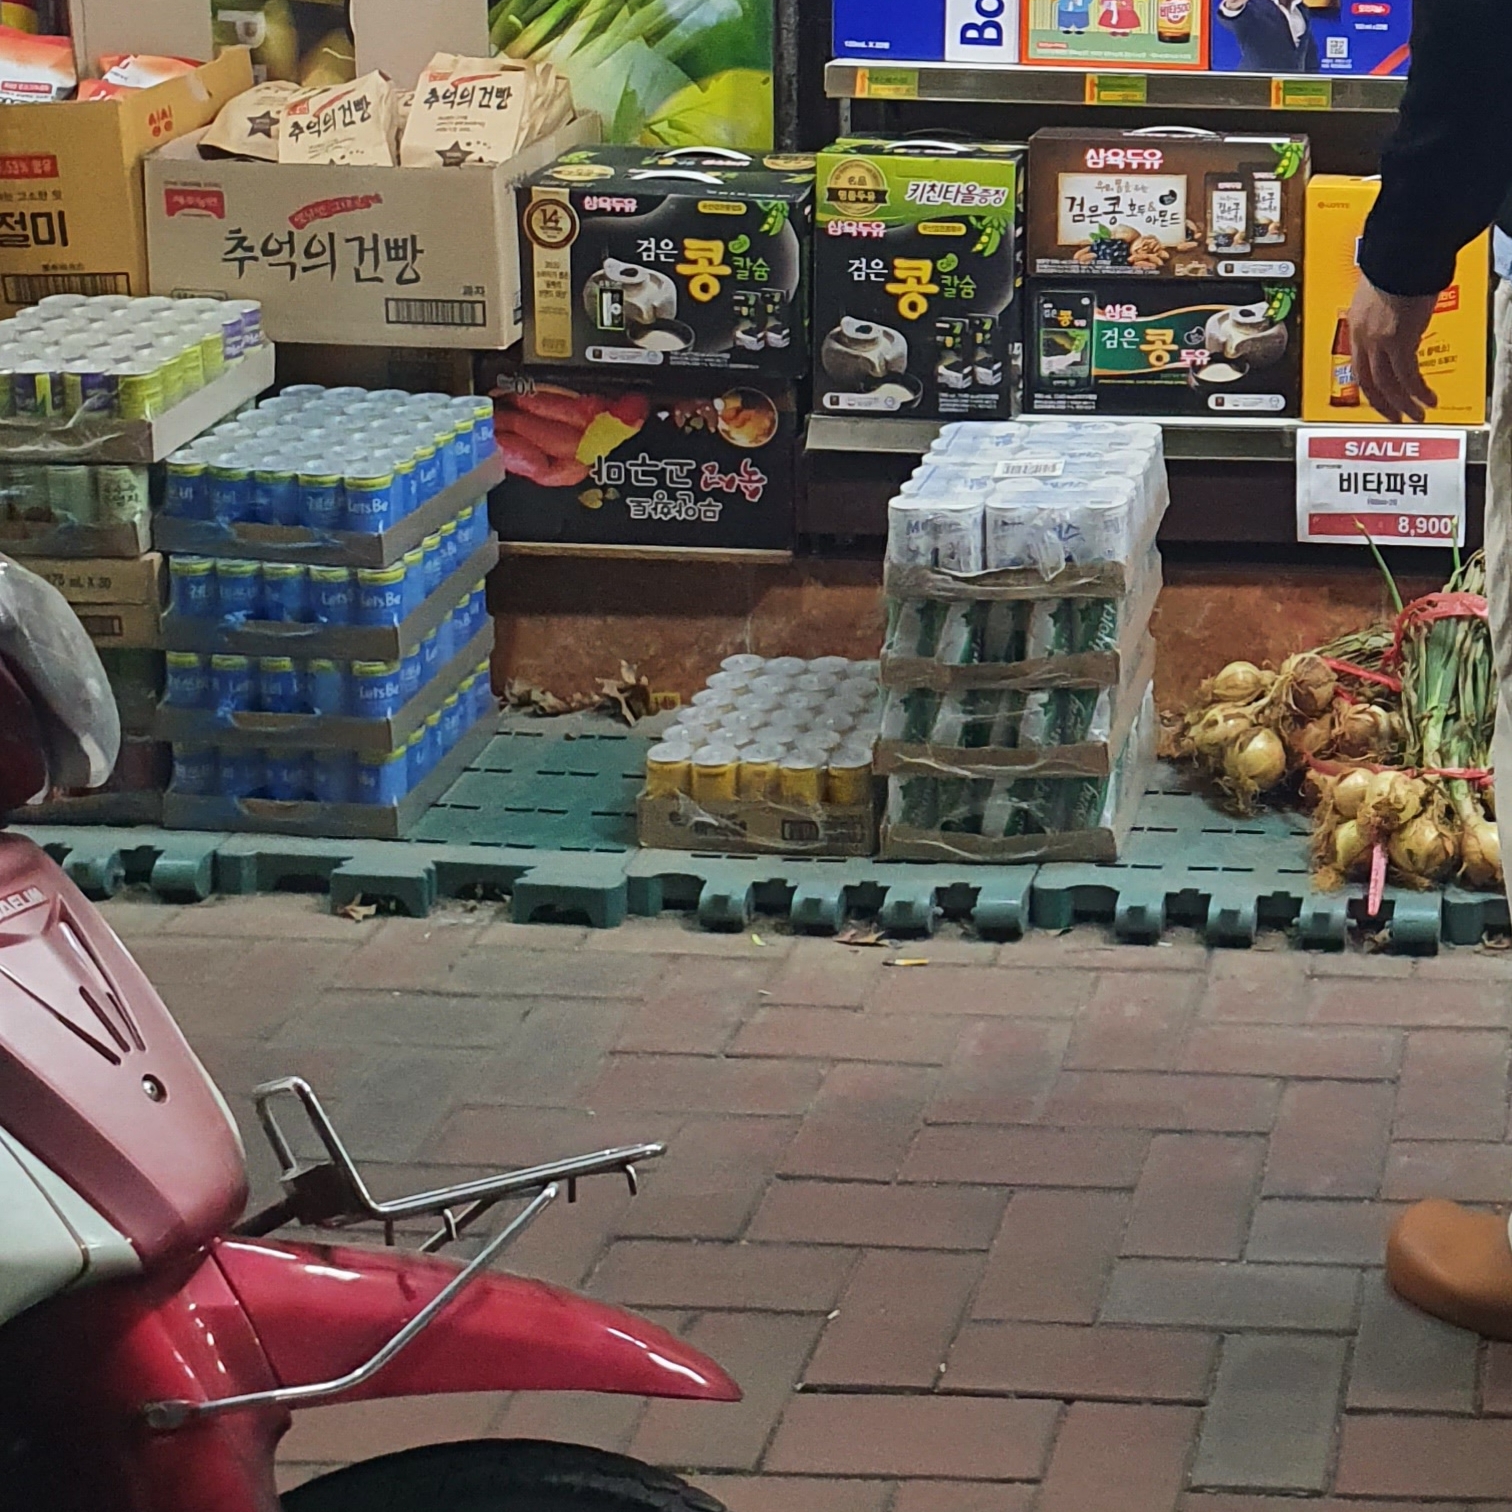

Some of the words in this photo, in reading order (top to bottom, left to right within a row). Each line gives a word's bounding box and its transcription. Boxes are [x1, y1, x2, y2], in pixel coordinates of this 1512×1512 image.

[1084, 147, 1164, 171] 삼육두유
[583, 195, 638, 213] 삼육두유
[1064, 194, 1125, 226] 검은콩
[1125, 197, 1146, 218] 호두
[827, 219, 888, 238] 삼육두유
[1144, 209, 1182, 228] 아몬드
[636, 237, 678, 263] 검은
[674, 237, 733, 303] 콩
[731, 256, 771, 282] 칼슘
[847, 257, 889, 282] 검은
[884, 257, 941, 321] 콩
[940, 274, 977, 300] 칼슘
[1104, 303, 1139, 322] 삼육
[1101, 327, 1140, 350] 검은
[1138, 327, 1179, 367] 콩
[1179, 348, 1212, 366] 두유
[1344, 441, 1421, 458] S/A/L/E
[589, 452, 697, 488] 고구마
[700, 457, 769, 503] 숙성
[1338, 471, 1430, 498] 비타파워
[626, 490, 724, 523] 무안황토
[1397, 515, 1452, 537] 8,900
